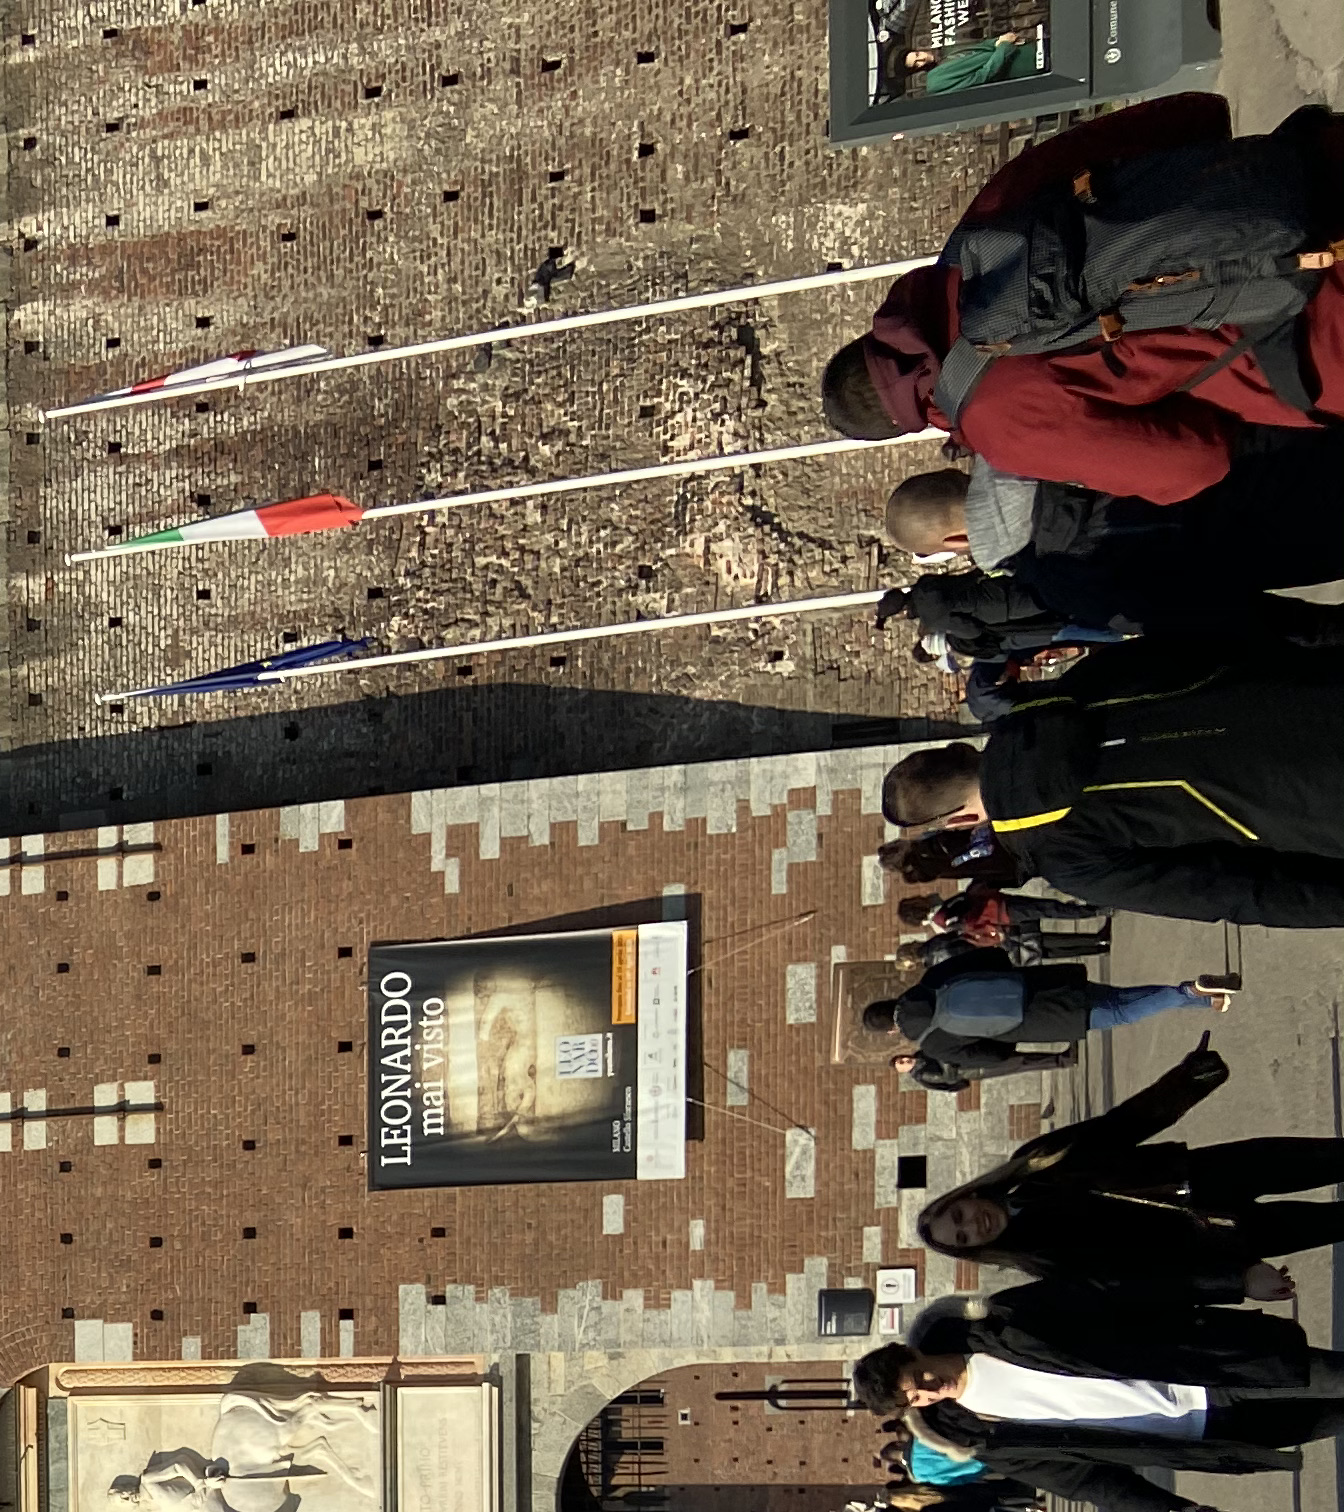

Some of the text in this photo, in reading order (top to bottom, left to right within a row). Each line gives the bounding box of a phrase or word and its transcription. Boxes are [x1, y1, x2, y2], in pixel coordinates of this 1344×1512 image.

[943, 0, 956, 46] FASHI
[1106, 0, 1118, 45] Comune
[380, 971, 413, 1167] LEONARDO
[413, 997, 445, 1136] mai visto
